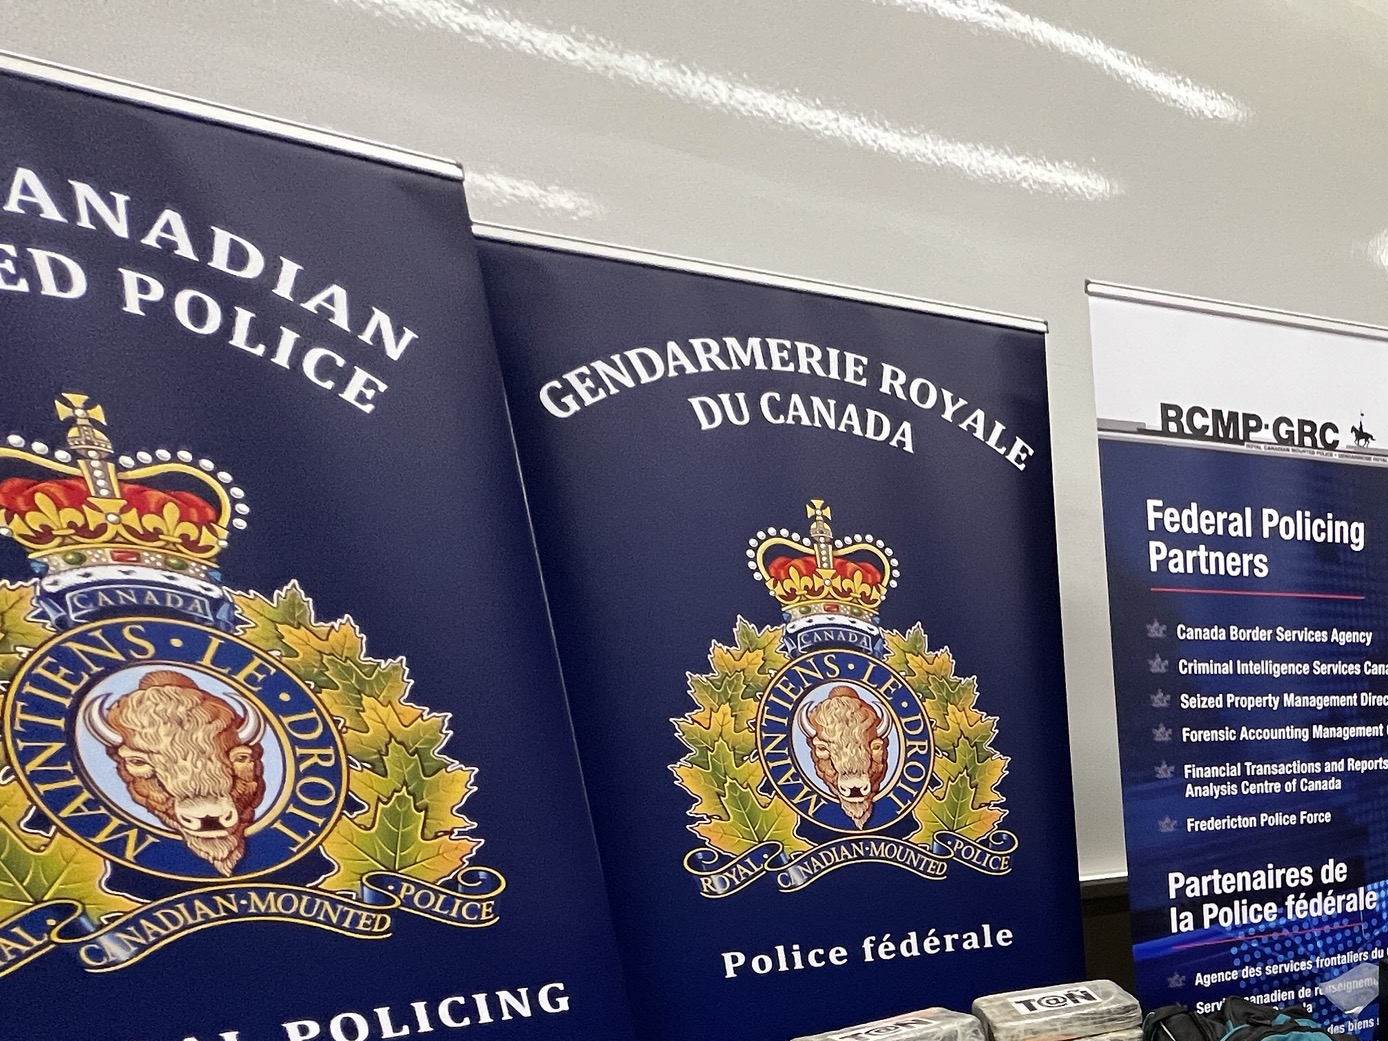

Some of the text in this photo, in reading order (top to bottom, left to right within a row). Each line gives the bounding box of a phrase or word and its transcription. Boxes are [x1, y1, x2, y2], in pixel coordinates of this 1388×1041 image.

[118, 268, 388, 414] POLICE
[539, 337, 1035, 472] GENDARMERIE ROYALE
[687, 392, 914, 454] DU CANADA
[1146, 499, 1365, 551] Federal Policing
[1148, 540, 1270, 578] Partners
[72, 586, 209, 615] CANADA
[801, 630, 870, 648] CANADA
[1177, 624, 1372, 646] Canada Border Services Agency
[1178, 659, 1233, 675] Criminal
[1236, 659, 1310, 678] Intelligence
[1312, 660, 1361, 675] Services
[1180, 693, 1223, 709] Seized
[1227, 692, 1280, 711] Property
[1283, 692, 1358, 710] Management
[15, 622, 338, 860] MAINTIENS LE DROIT
[761, 654, 929, 816] MAINTIENS LE DROIT
[1182, 726, 1237, 742] Forensic
[1240, 725, 1309, 741] Accounting
[1312, 724, 1383, 740] Management
[1184, 762, 1241, 779] Financial
[1244, 760, 1322, 776] Transactions
[1324, 758, 1344, 773] and
[1185, 777, 1342, 800] Analysis Centre of Canada
[1187, 810, 1332, 832] Fredericton Police Force
[701, 857, 765, 894] ROYAL
[953, 839, 1010, 872] POLICE
[1168, 858, 1348, 899] Partenaires de
[398, 881, 496, 922] POLICE
[1170, 887, 1378, 933] la Police fédérale
[721, 923, 1014, 979] Police fédérale
[1195, 969, 1238, 988] Agence
[1241, 965, 1262, 979] des
[1265, 960, 1313, 976] services
[1315, 950, 1369, 969] frontaliers
[1371, 946, 1384, 959] du
[1298, 985, 1311, 999] de
[1328, 1020, 1345, 1035] des
[1348, 1017, 1375, 1033] biens
